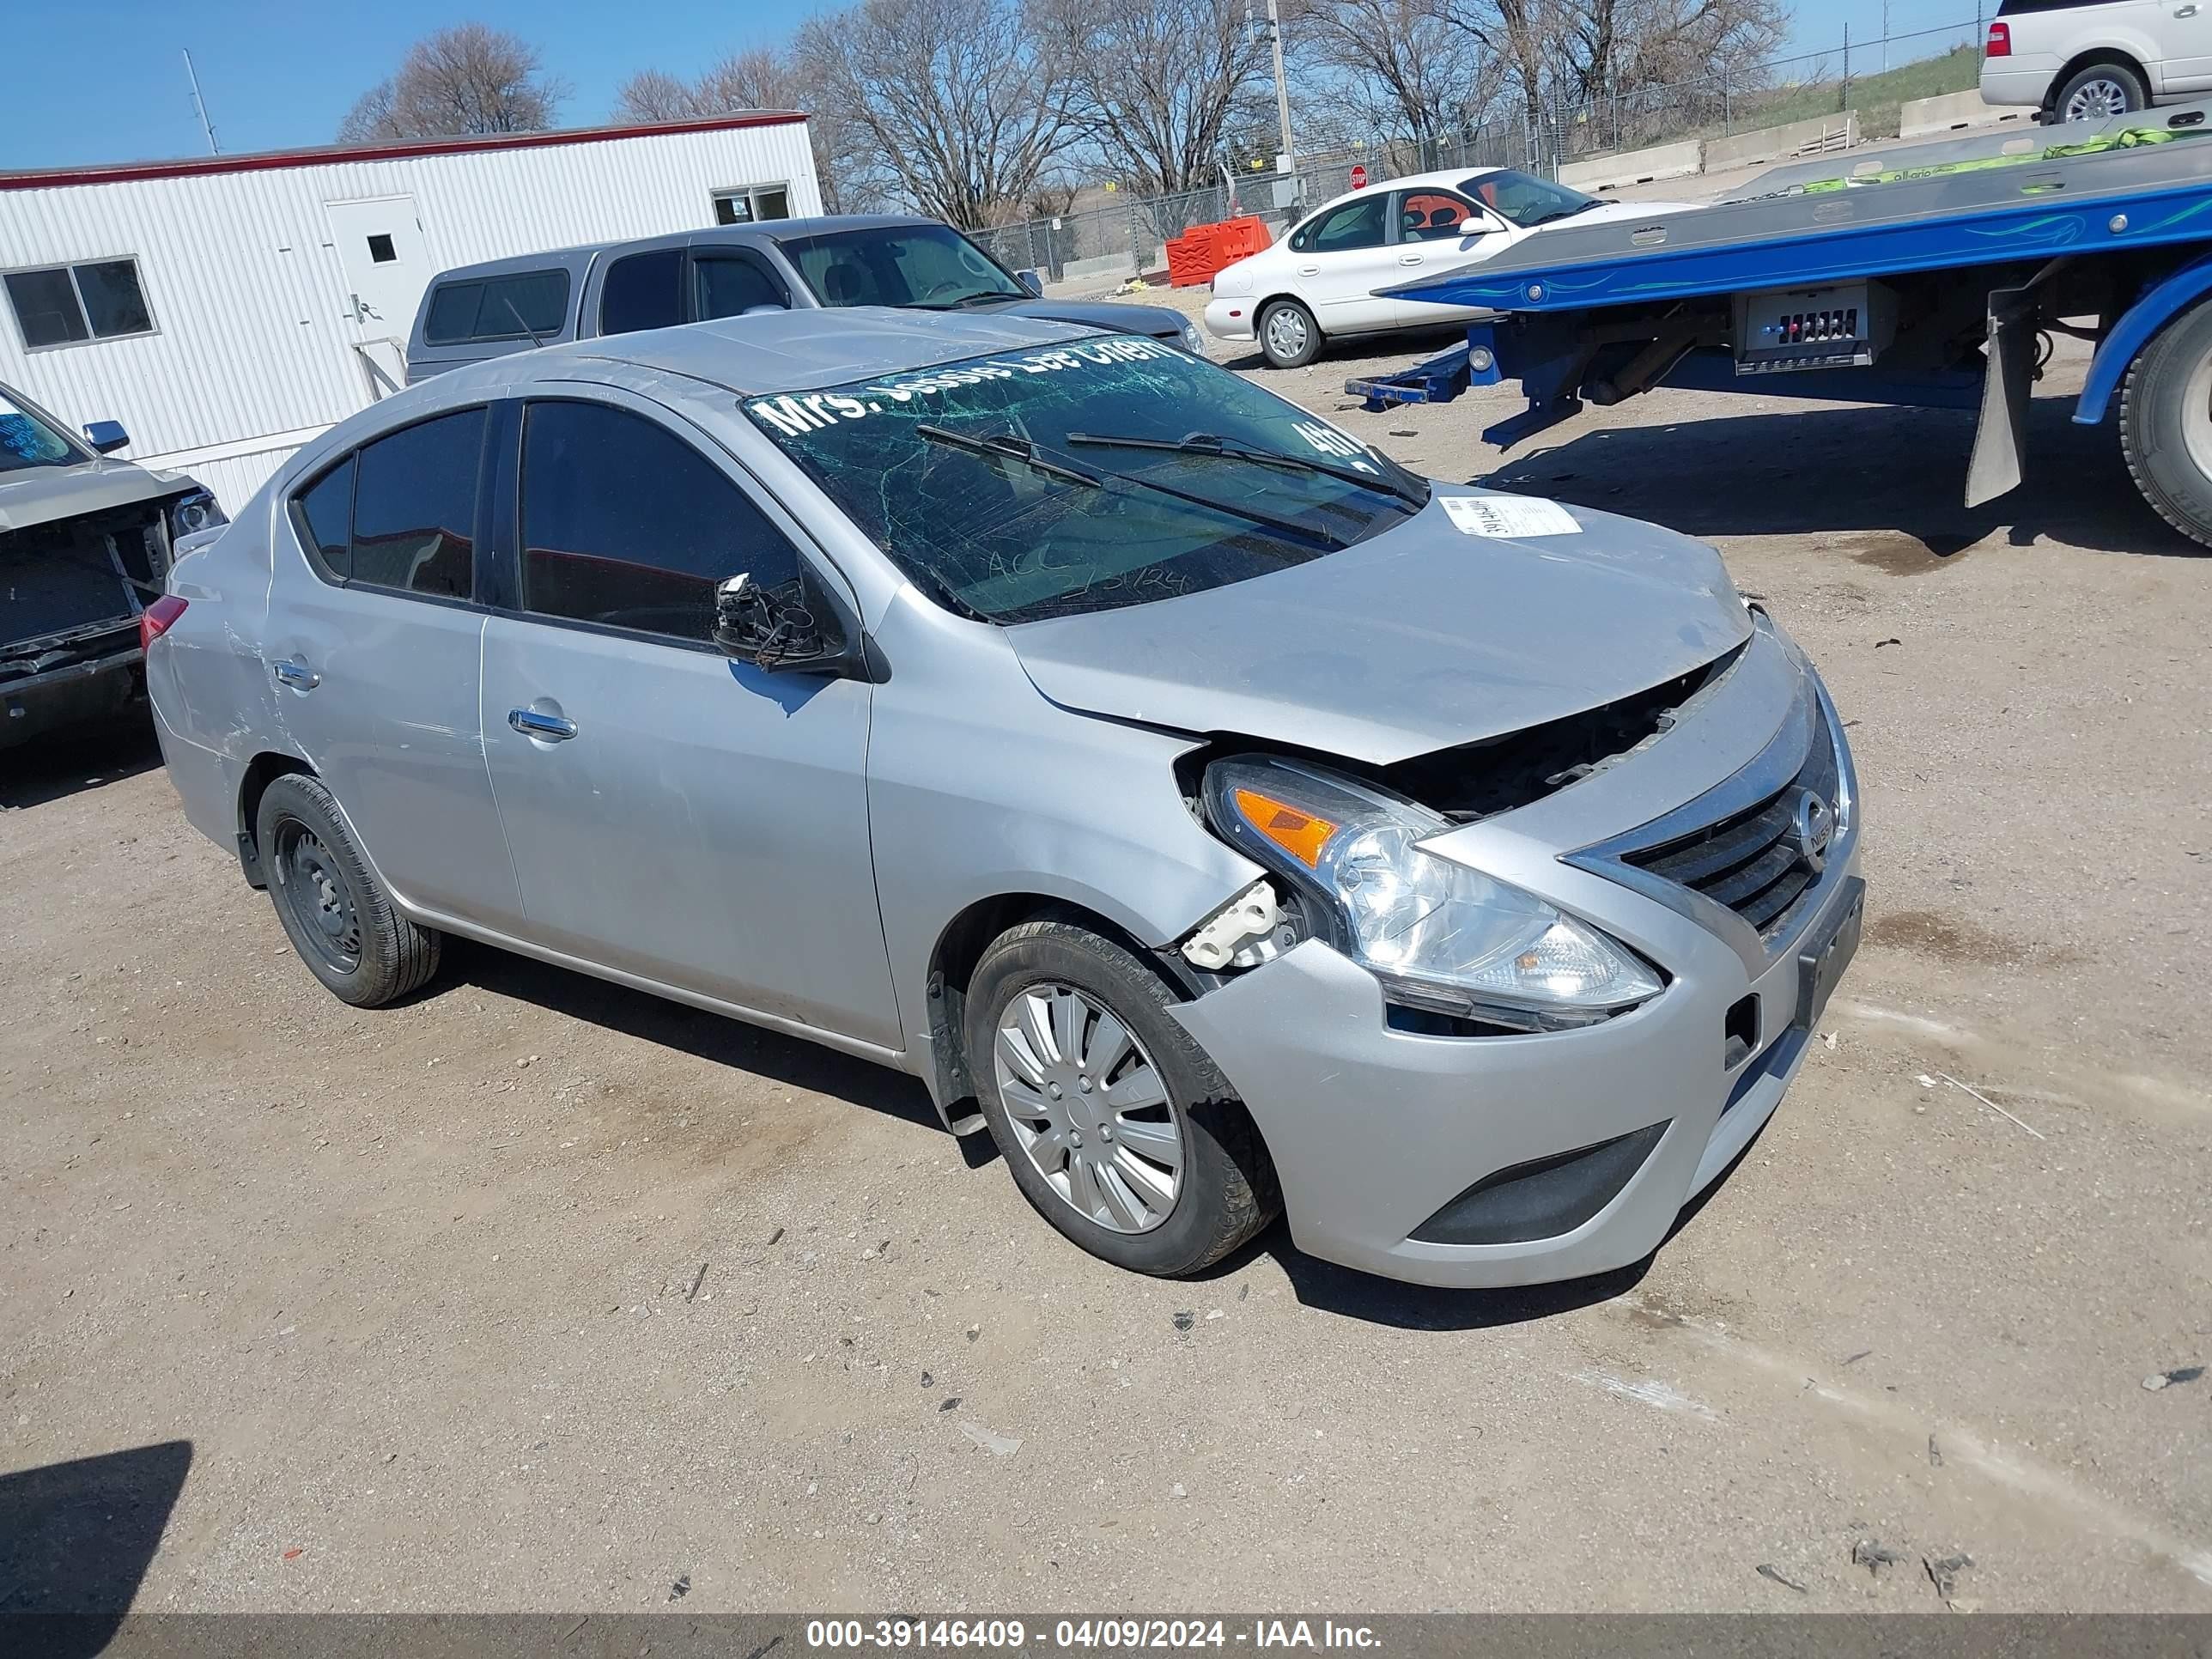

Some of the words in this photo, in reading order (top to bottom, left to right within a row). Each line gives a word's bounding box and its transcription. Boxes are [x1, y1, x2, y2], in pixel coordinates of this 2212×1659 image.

[1352, 173, 1366, 185] STOP
[750, 394, 883, 437] Mrs.
[866, 366, 1012, 402] Jessie
[986, 351, 1082, 374] Lee
[1061, 341, 1196, 365] Cherry
[1291, 421, 1363, 457] 4th
